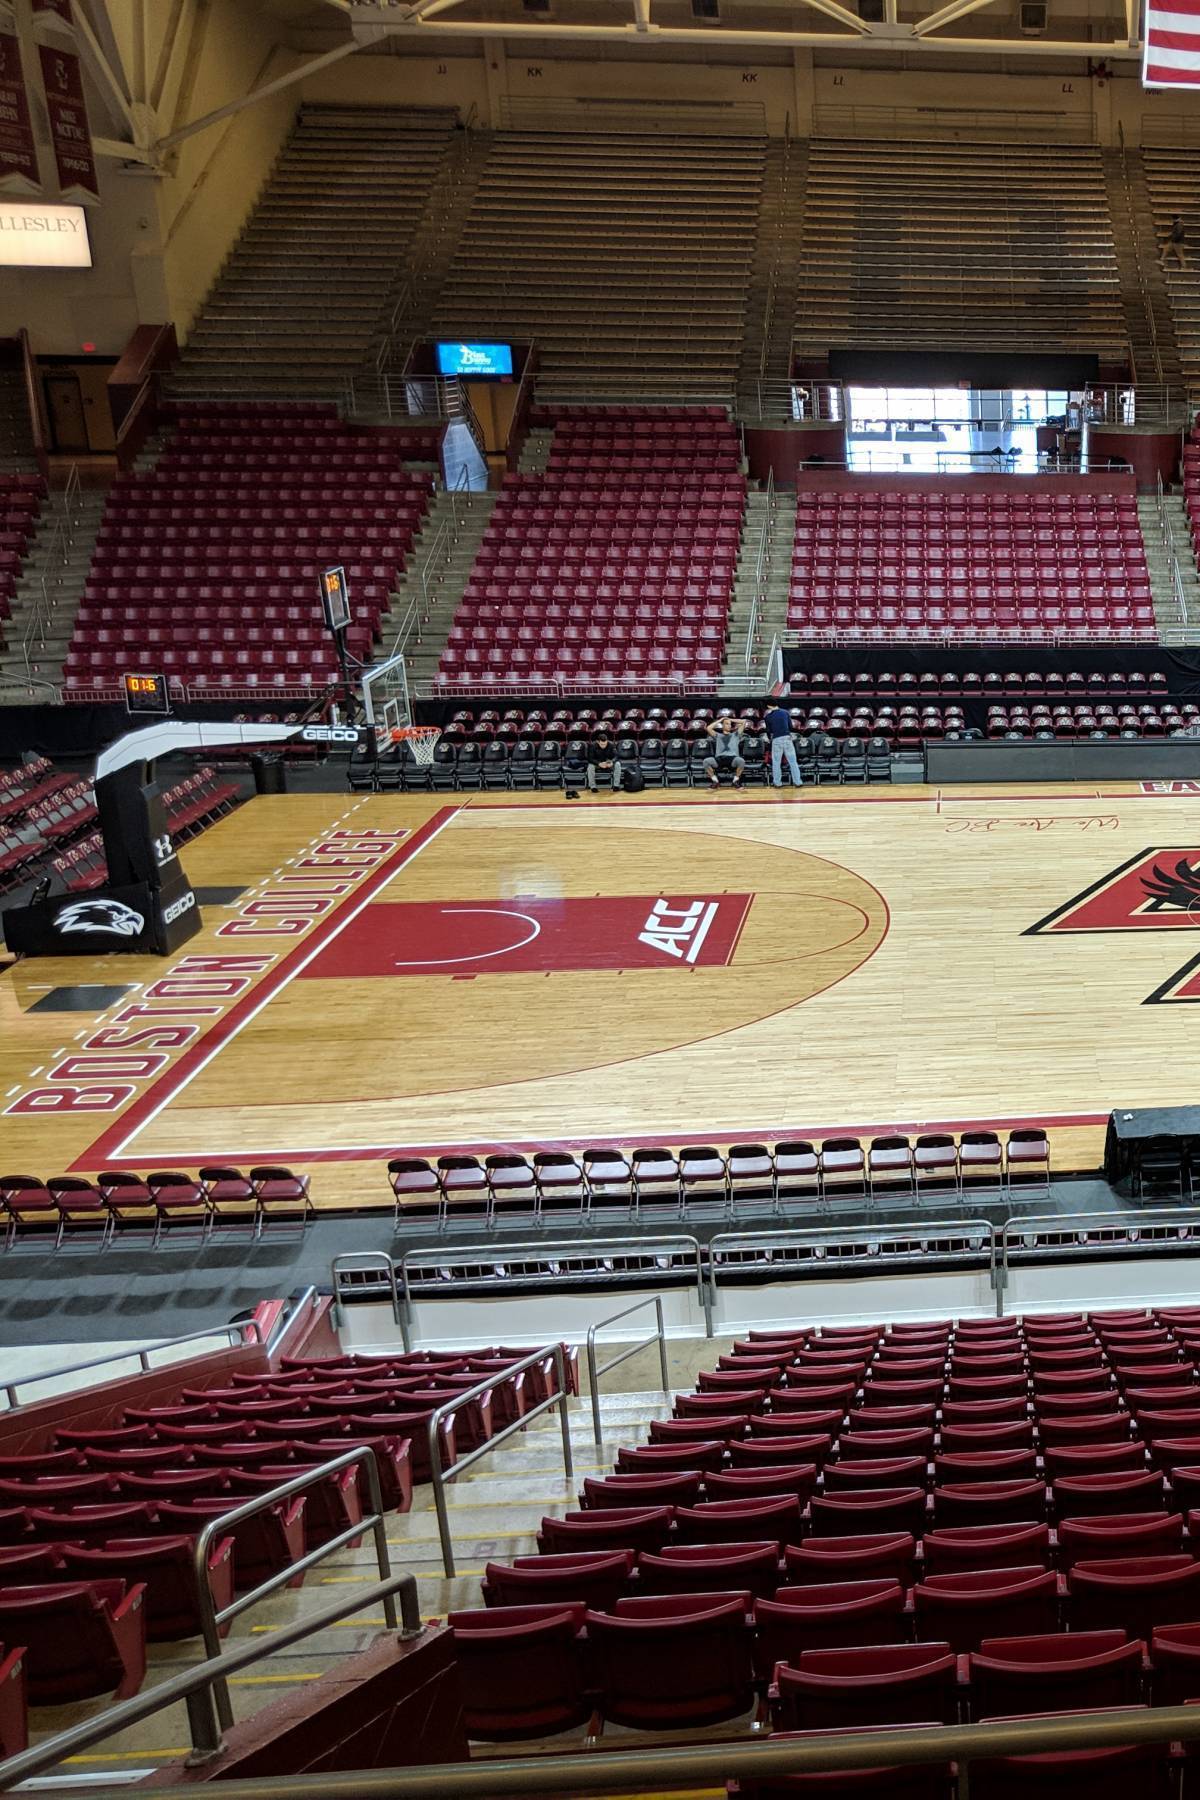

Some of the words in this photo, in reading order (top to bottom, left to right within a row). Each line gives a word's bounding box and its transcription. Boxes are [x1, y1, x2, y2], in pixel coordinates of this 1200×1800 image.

[527, 67, 543, 77] KK
[742, 73, 758, 82] KK
[1062, 83, 1074, 93] LL
[303, 729, 358, 741] GEICO
[164, 891, 196, 924] GEICO
[637, 898, 706, 959] ACC
[2, 953, 280, 1116] BOSTON
[214, 828, 413, 937] COLLEGE
